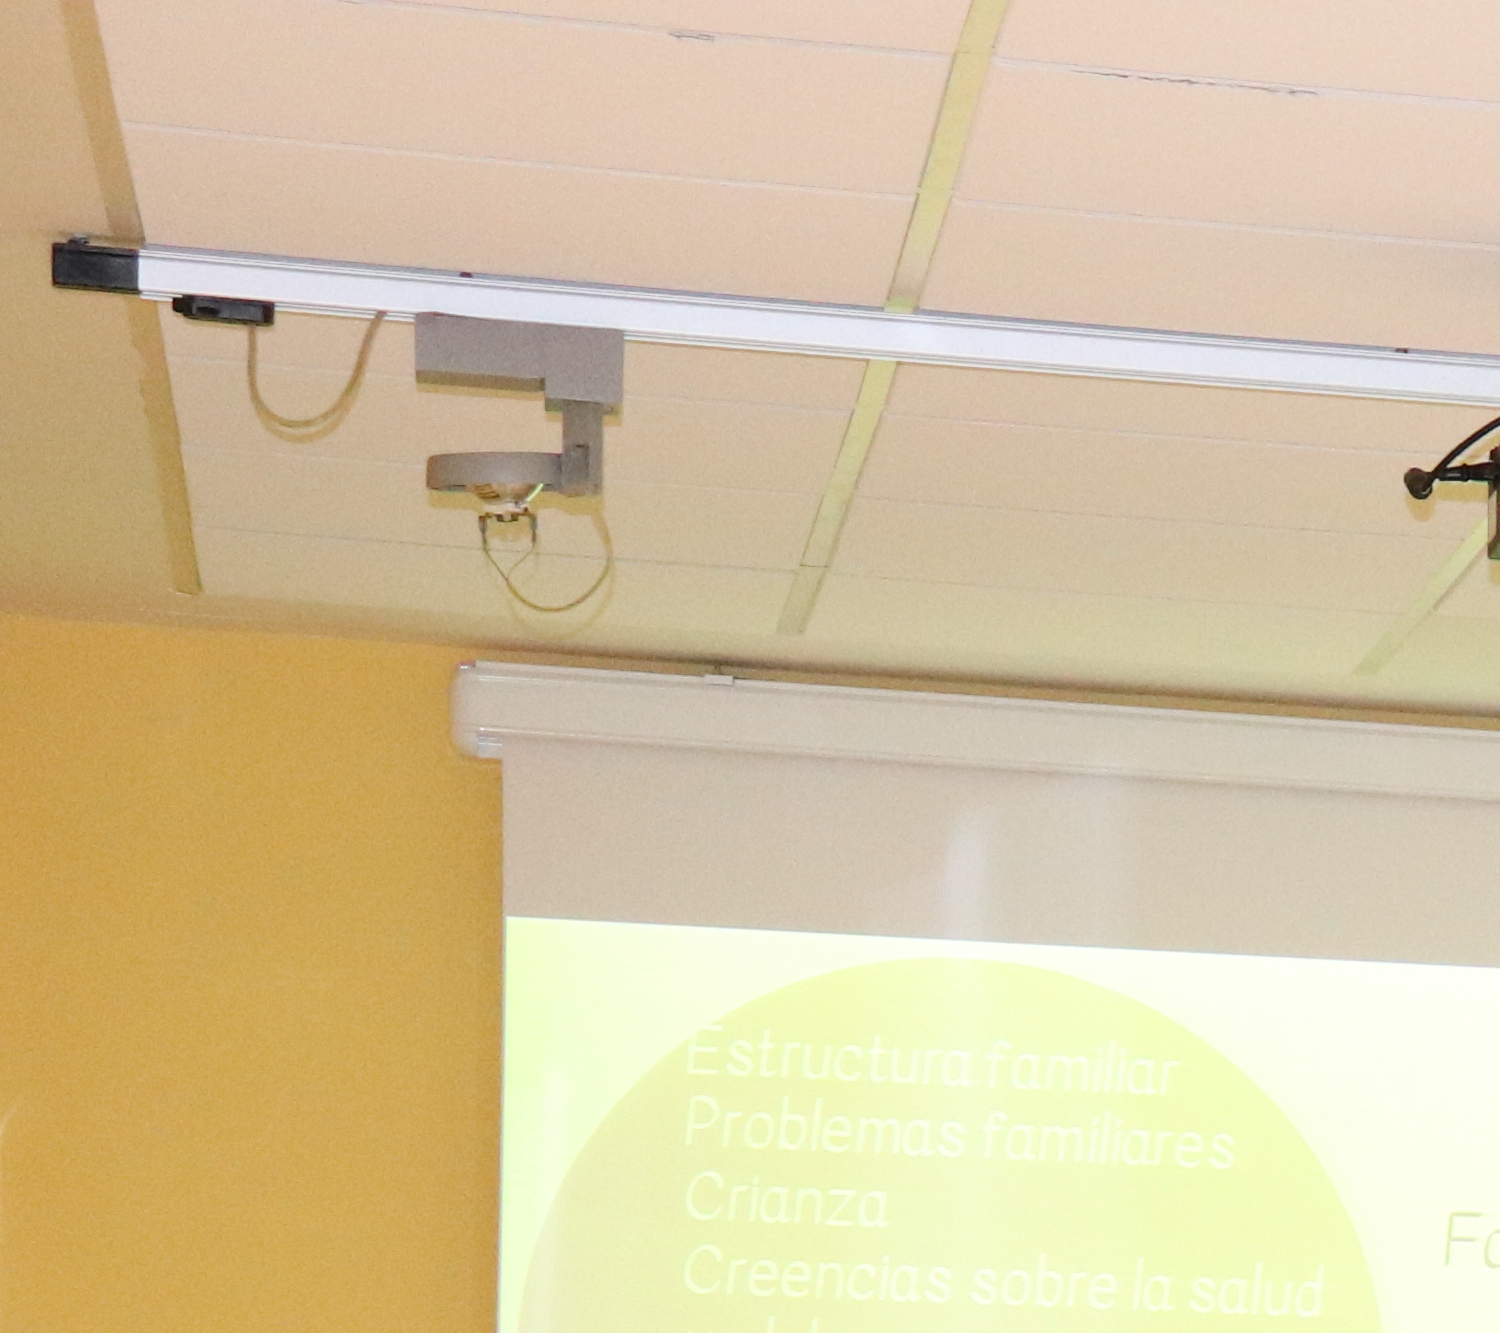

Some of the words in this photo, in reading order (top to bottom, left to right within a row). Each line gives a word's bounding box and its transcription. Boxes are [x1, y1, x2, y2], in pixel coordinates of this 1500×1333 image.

[684, 1024, 973, 1089] Estructura
[985, 1040, 1179, 1096] familiar
[684, 1096, 964, 1157] Problemas
[983, 1112, 1235, 1169] familiares
[684, 1171, 890, 1227] Crianza
[683, 1245, 952, 1304] Creencias
[971, 1254, 1118, 1309] sobre
[1131, 1258, 1173, 1312] la
[1189, 1263, 1324, 1317] salud
